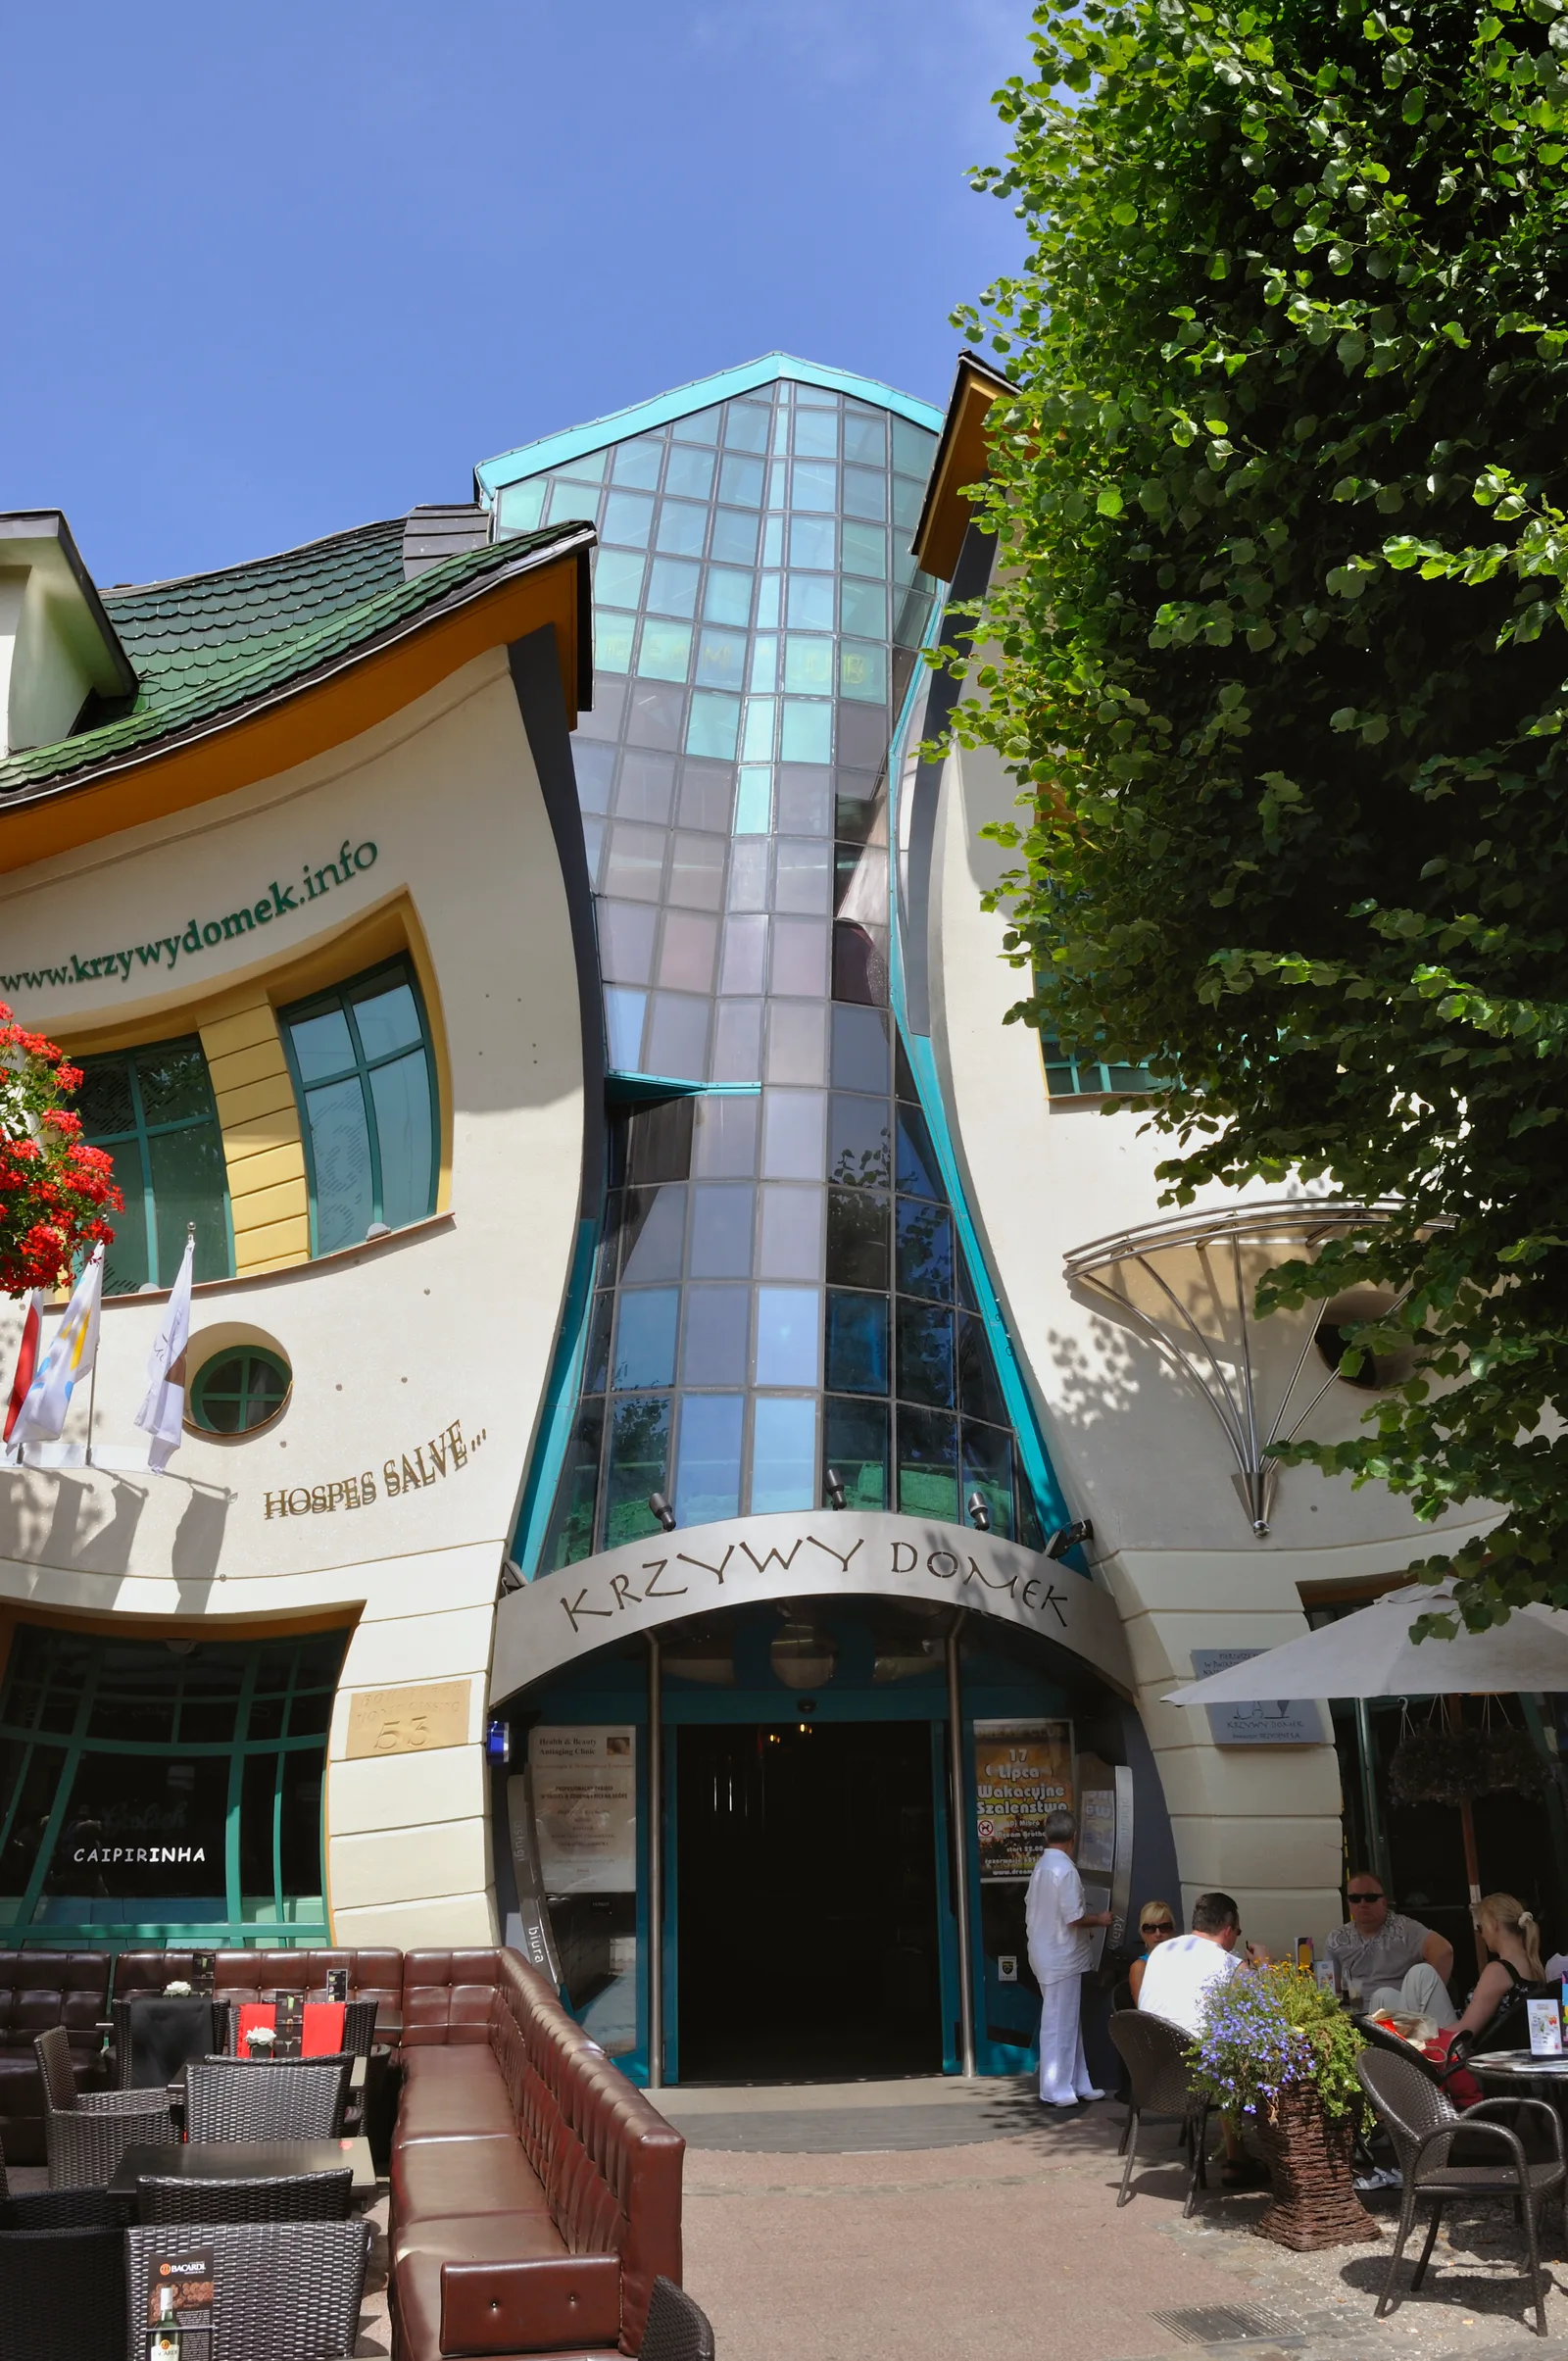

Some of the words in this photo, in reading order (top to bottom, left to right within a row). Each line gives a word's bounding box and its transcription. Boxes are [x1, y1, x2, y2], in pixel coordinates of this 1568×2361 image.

[0, 839, 378, 992] www.krzywydomek.info
[263, 1471, 376, 1520] HOSPES
[560, 1535, 864, 1633] KRZYWY
[891, 1541, 1068, 1627] DOMEK
[373, 1715, 430, 1749] 53
[572, 1738, 597, 1747] Beauty
[1008, 1747, 1027, 1763] 17
[999, 1763, 1040, 1783] Lipca
[977, 1782, 1065, 1801] Wakacyjne
[74, 1846, 206, 1862] CAIPIRINHA
[528, 1926, 544, 1963] biura
[1107, 1914, 1125, 1951] klepy
